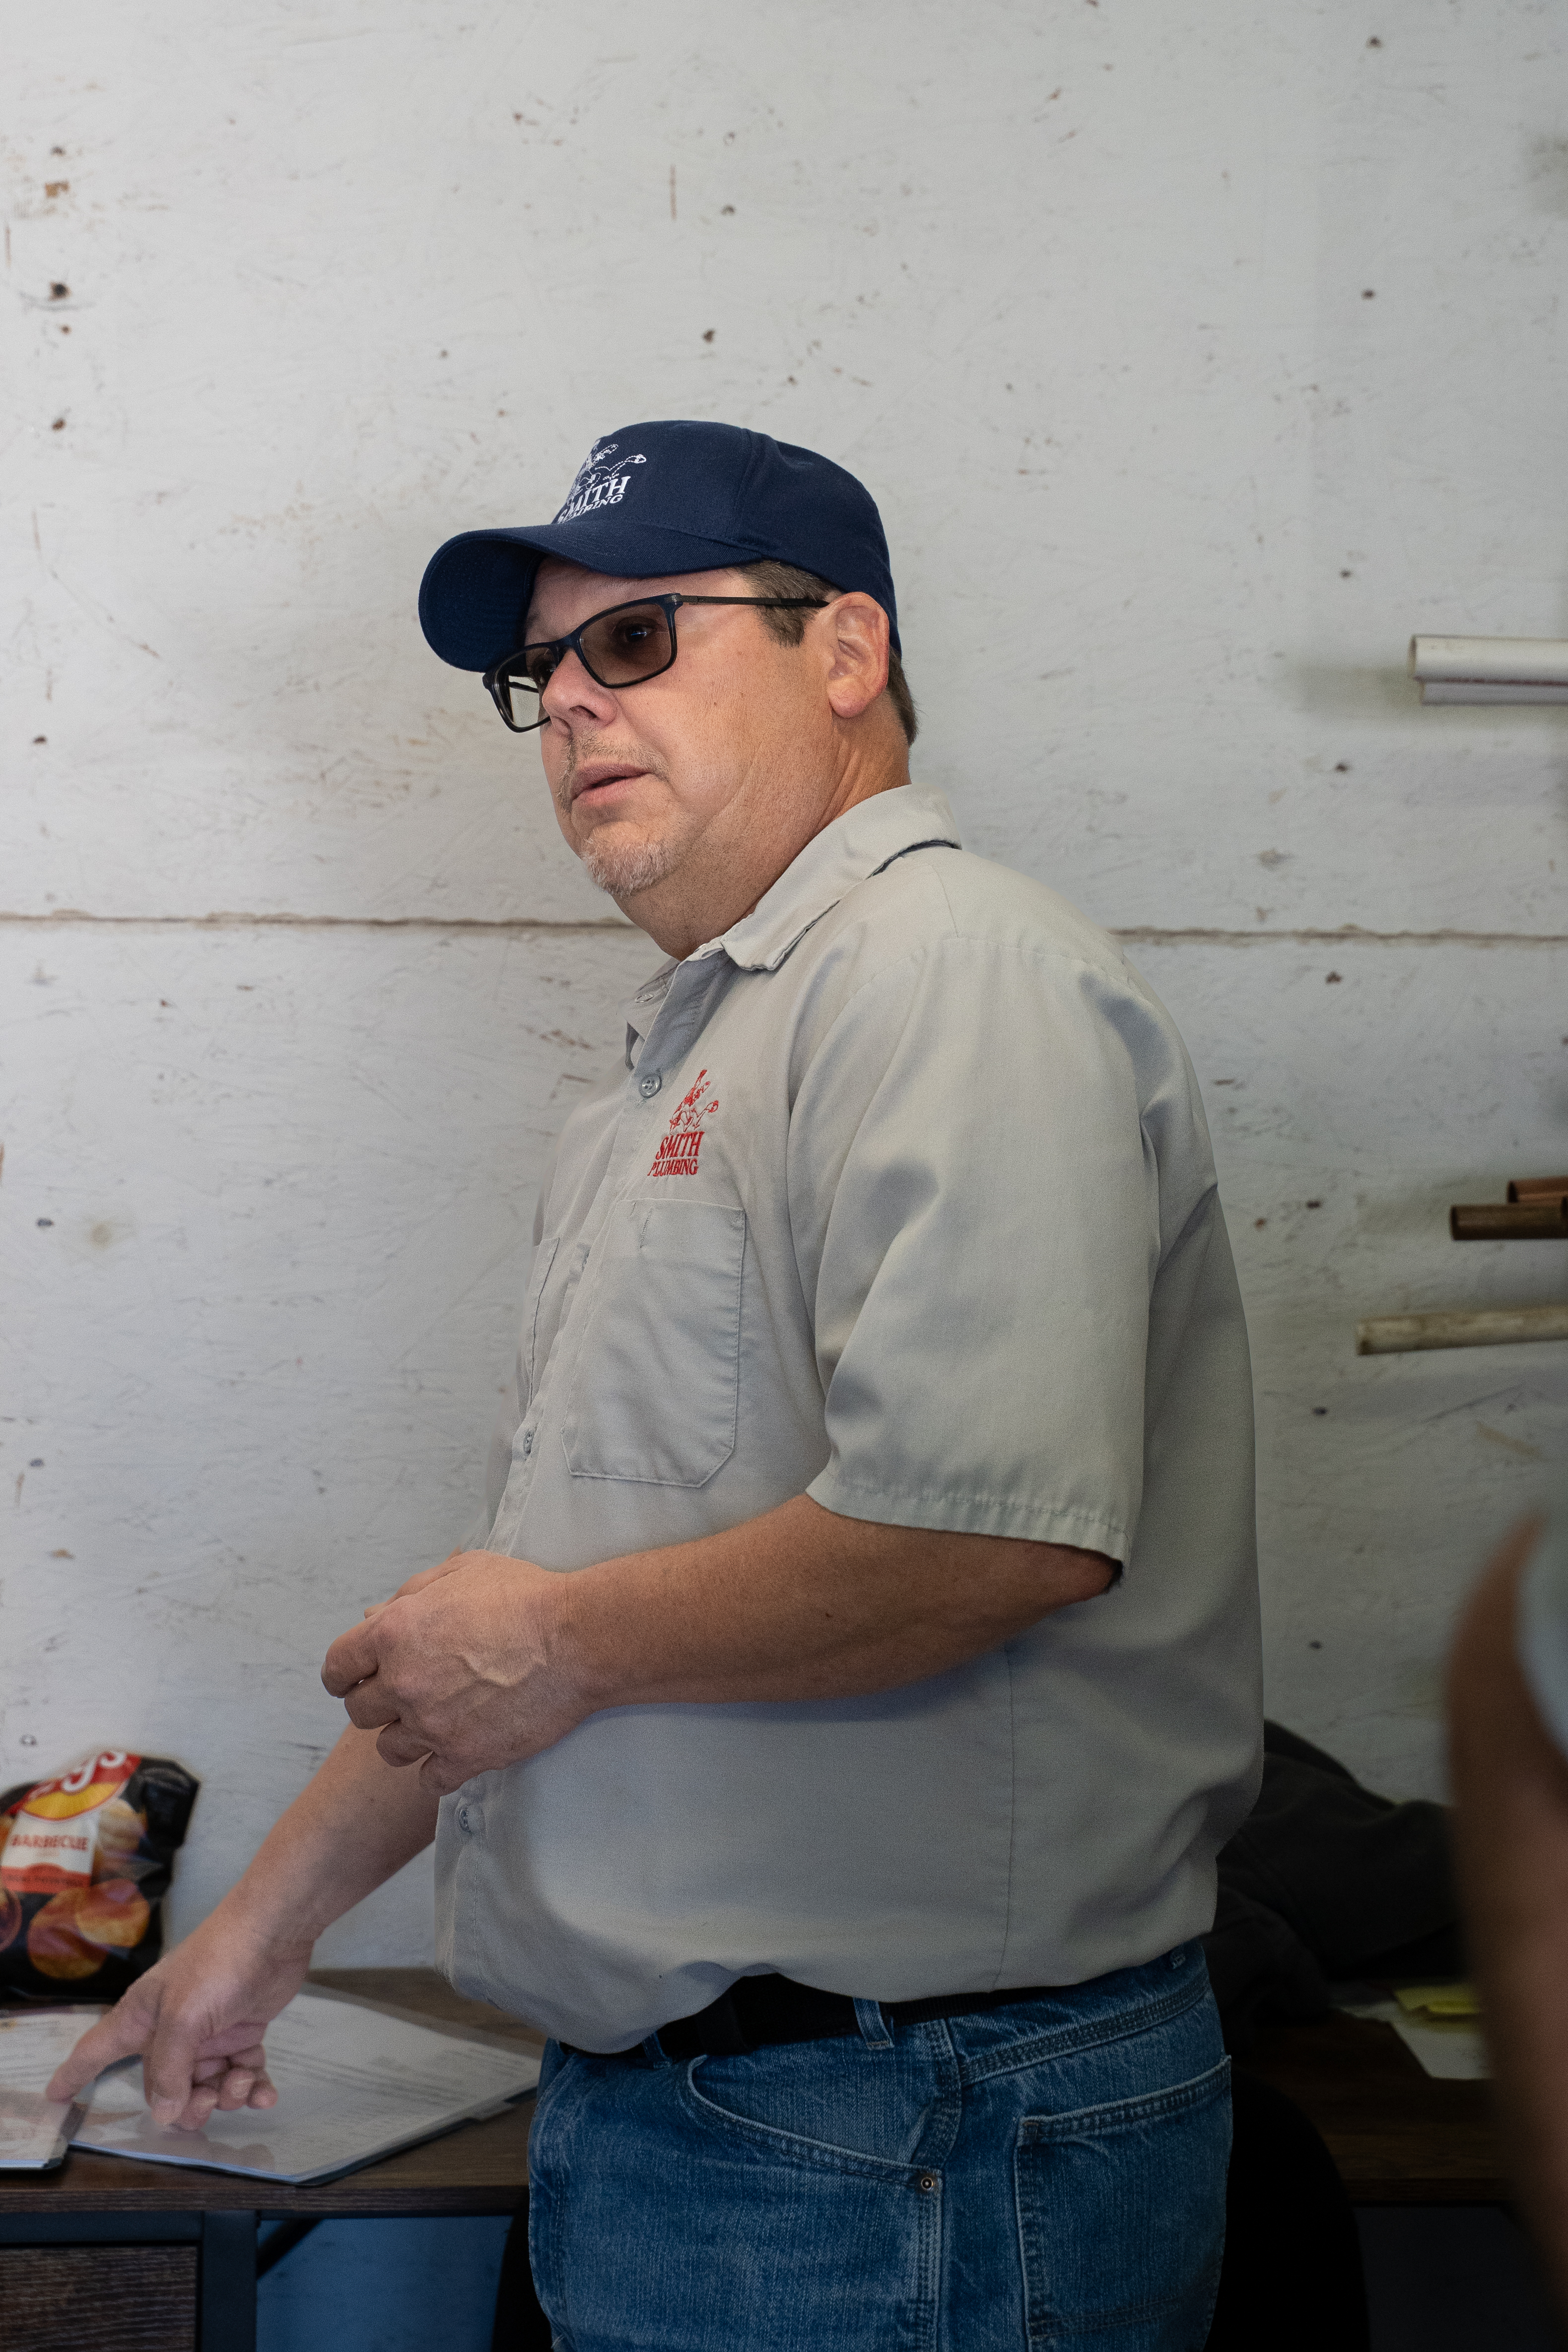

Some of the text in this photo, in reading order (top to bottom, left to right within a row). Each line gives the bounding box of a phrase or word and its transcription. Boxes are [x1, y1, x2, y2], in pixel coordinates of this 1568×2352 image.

[557, 475, 631, 524] SMITH
[655, 1131, 705, 1160] SMITH
[647, 1158, 699, 1177] PLUMBING
